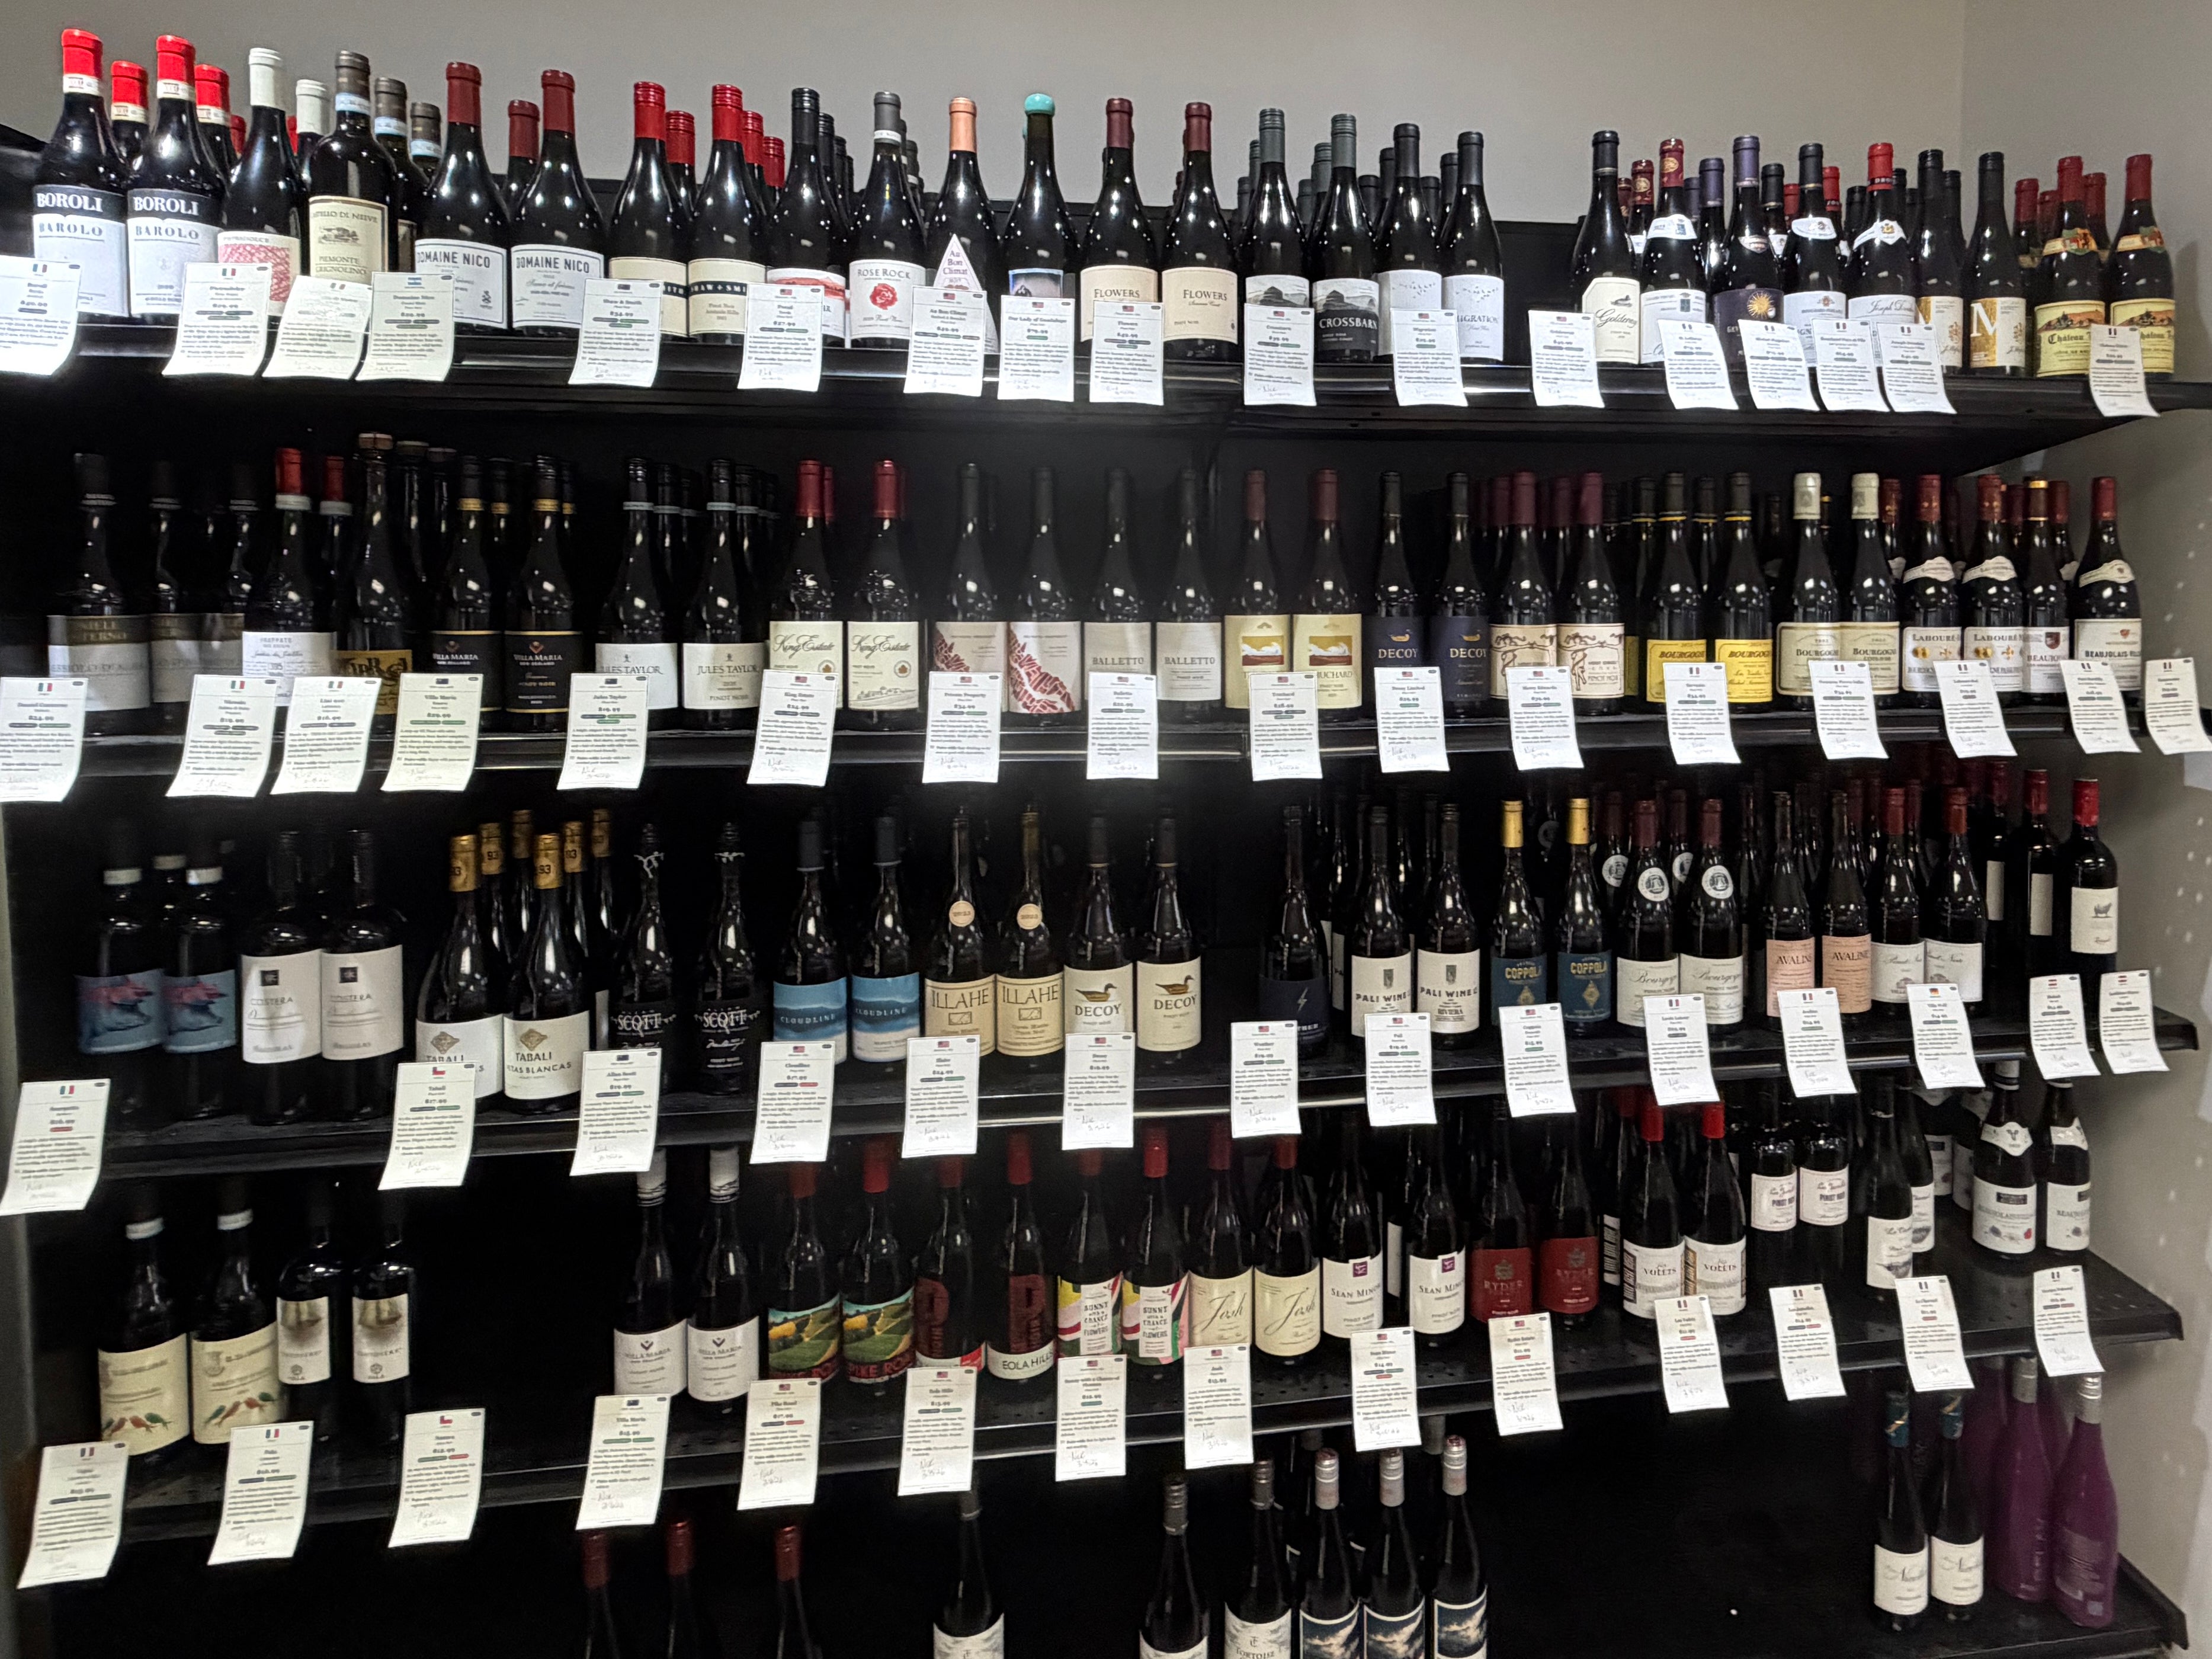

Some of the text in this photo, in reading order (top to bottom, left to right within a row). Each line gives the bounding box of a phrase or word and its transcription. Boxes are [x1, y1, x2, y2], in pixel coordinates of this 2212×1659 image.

[37, 193, 103, 212] BOROLI
[133, 196, 199, 216] BOROLI
[39, 222, 103, 236] BAROLO
[135, 225, 200, 239] BAROLO
[318, 255, 359, 265] PIEMONTE
[463, 254, 491, 269] NICO
[948, 258, 963, 267] Bon
[516, 258, 590, 275] DOMAINE NICO
[942, 267, 969, 276] Climat
[858, 268, 911, 279] ROSE ROCK
[1094, 288, 1140, 299] FLOWERS
[1182, 289, 1227, 301] FLOWERS
[1319, 317, 1378, 330] CROSSBARN
[772, 633, 835, 659] King Estate
[851, 633, 911, 659] King Estate
[1378, 648, 1418, 659] DECOY
[1092, 656, 1145, 665] BALLETTO
[1164, 656, 1216, 665] BALLETTO
[625, 665, 663, 675] TAYLOR
[698, 665, 724, 677] JULES
[1002, 984, 1059, 1004] ILLAHE
[1420, 985, 1472, 997] PALI WINE
[931, 987, 989, 1009] ILLAHE
[1154, 995, 1198, 1010] DECOY
[1355, 992, 1406, 1003] PALI WINE
[1075, 1003, 1121, 1017] DECOY
[781, 1013, 835, 1024] CLOUDLINE
[515, 1052, 553, 1062] TABALI
[525, 1062, 572, 1074] BLANCAS
[1331, 1288, 1354, 1298] SEAN
[1419, 1283, 1442, 1294] SEAN
[1084, 1302, 1108, 1312] SUNNY
[1143, 1306, 1168, 1314] SUNNY
[1191, 1290, 1247, 1332] Josh
[1264, 1287, 1319, 1336] Josh
[1003, 1359, 1030, 1370] EOLA
